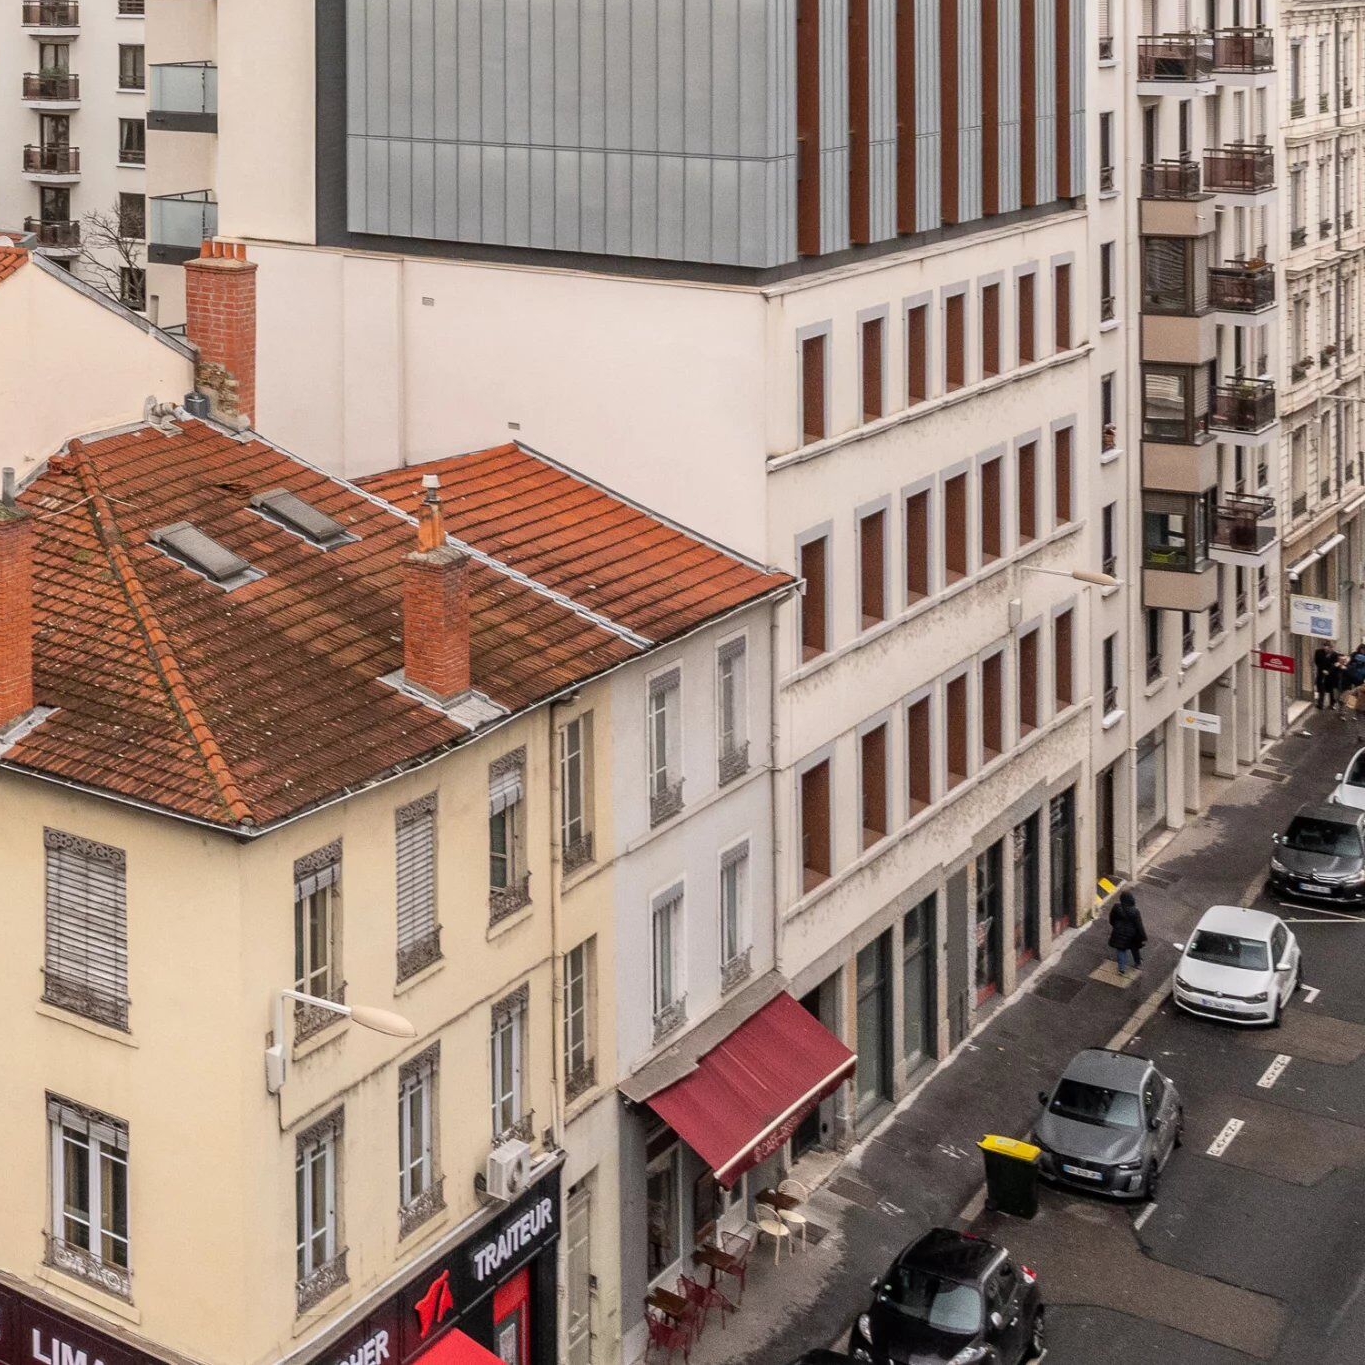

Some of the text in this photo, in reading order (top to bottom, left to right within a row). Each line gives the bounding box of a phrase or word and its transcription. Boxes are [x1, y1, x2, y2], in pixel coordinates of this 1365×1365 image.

[474, 1197, 553, 1282] TRAITEUR
[32, 1327, 106, 1365] LIM
[339, 1330, 390, 1365] HER
